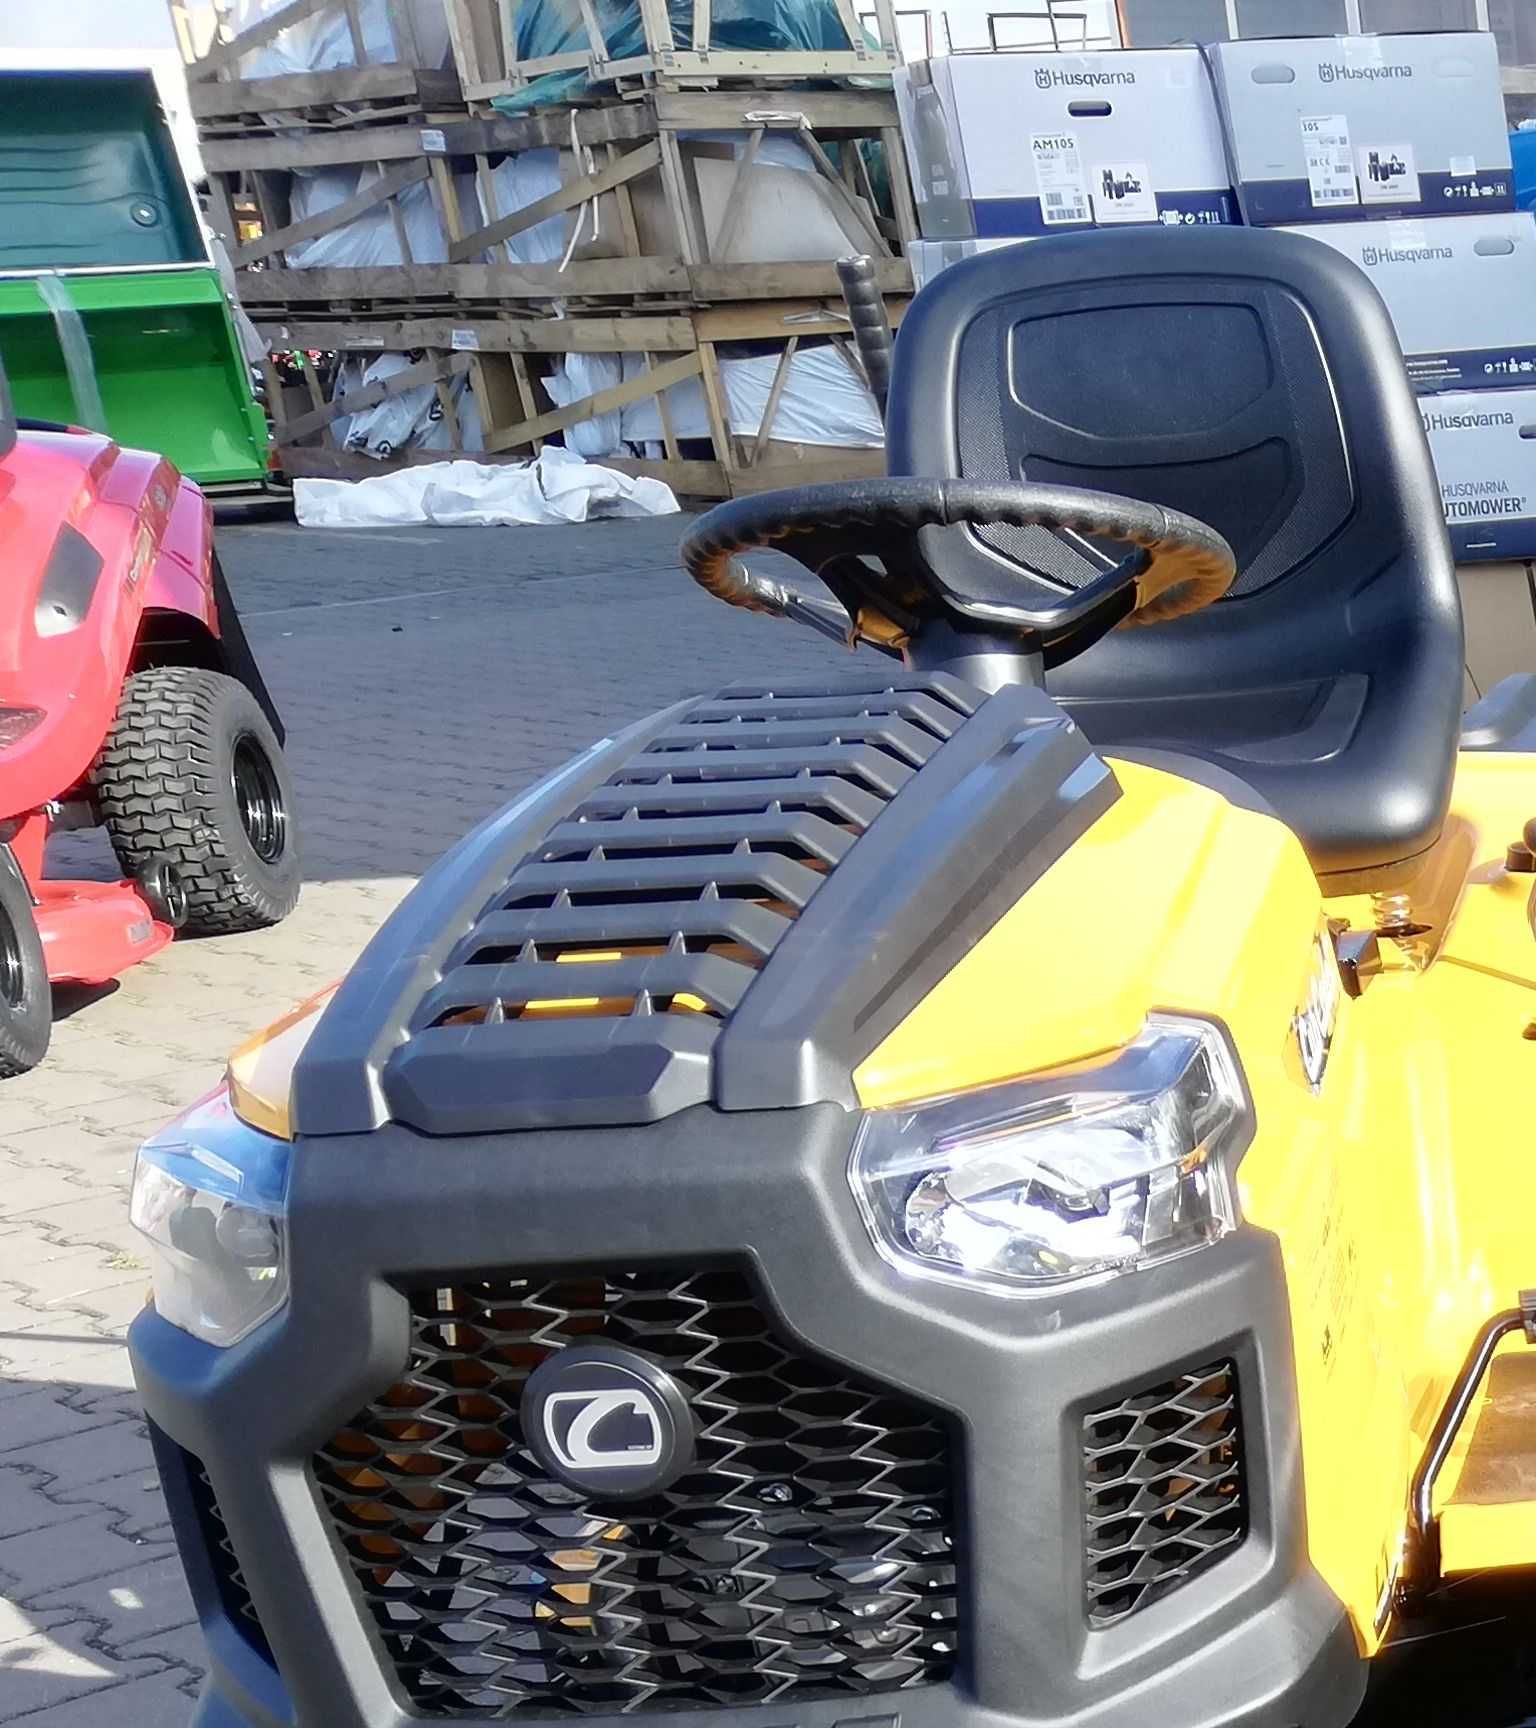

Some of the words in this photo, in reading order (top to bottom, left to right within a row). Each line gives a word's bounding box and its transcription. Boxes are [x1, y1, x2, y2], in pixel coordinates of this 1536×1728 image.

[1052, 70, 1136, 87] Husqvarna
[1336, 64, 1413, 81] Husqvarna
[1032, 138, 1075, 151] AM105
[1378, 247, 1454, 264] Husqvarna
[1432, 411, 1515, 431] Husqvarna
[1441, 480, 1510, 498] HUSQVARNA
